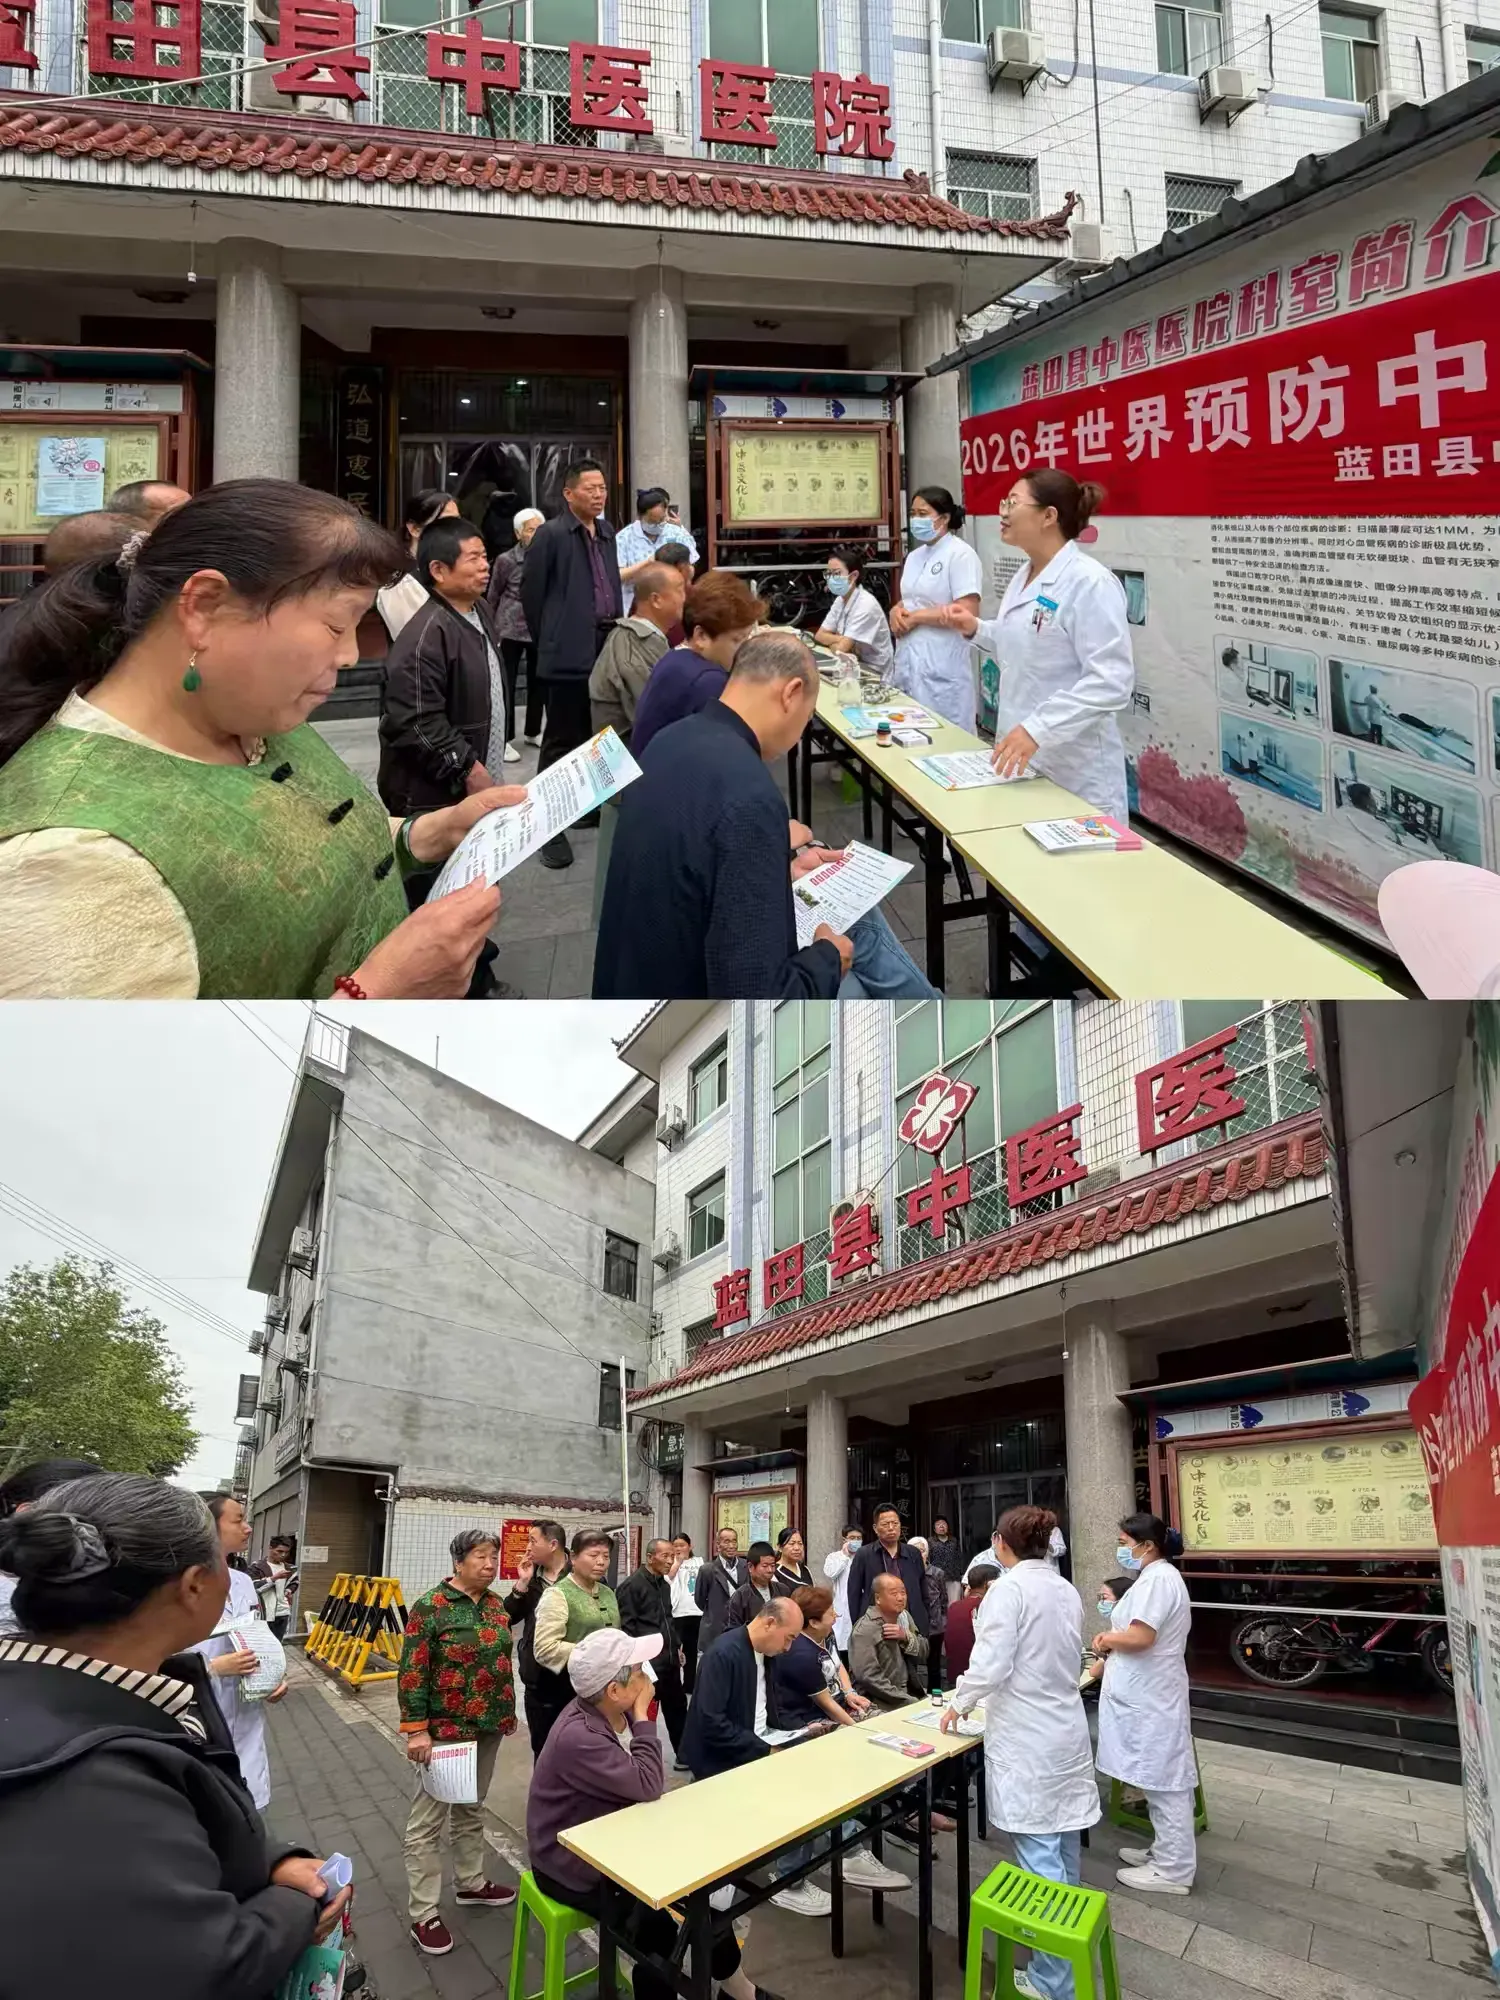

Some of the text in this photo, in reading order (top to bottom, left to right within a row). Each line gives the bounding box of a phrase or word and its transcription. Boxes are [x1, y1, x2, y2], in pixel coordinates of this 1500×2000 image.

[1019, 192, 1500, 402] 蓝田县中医医院科室简介
[961, 329, 1488, 476] 2026年世界预防中
[713, 1016, 1314, 1331] 蓝田县中医医
[1190, 1469, 1211, 1522] 中医文化
